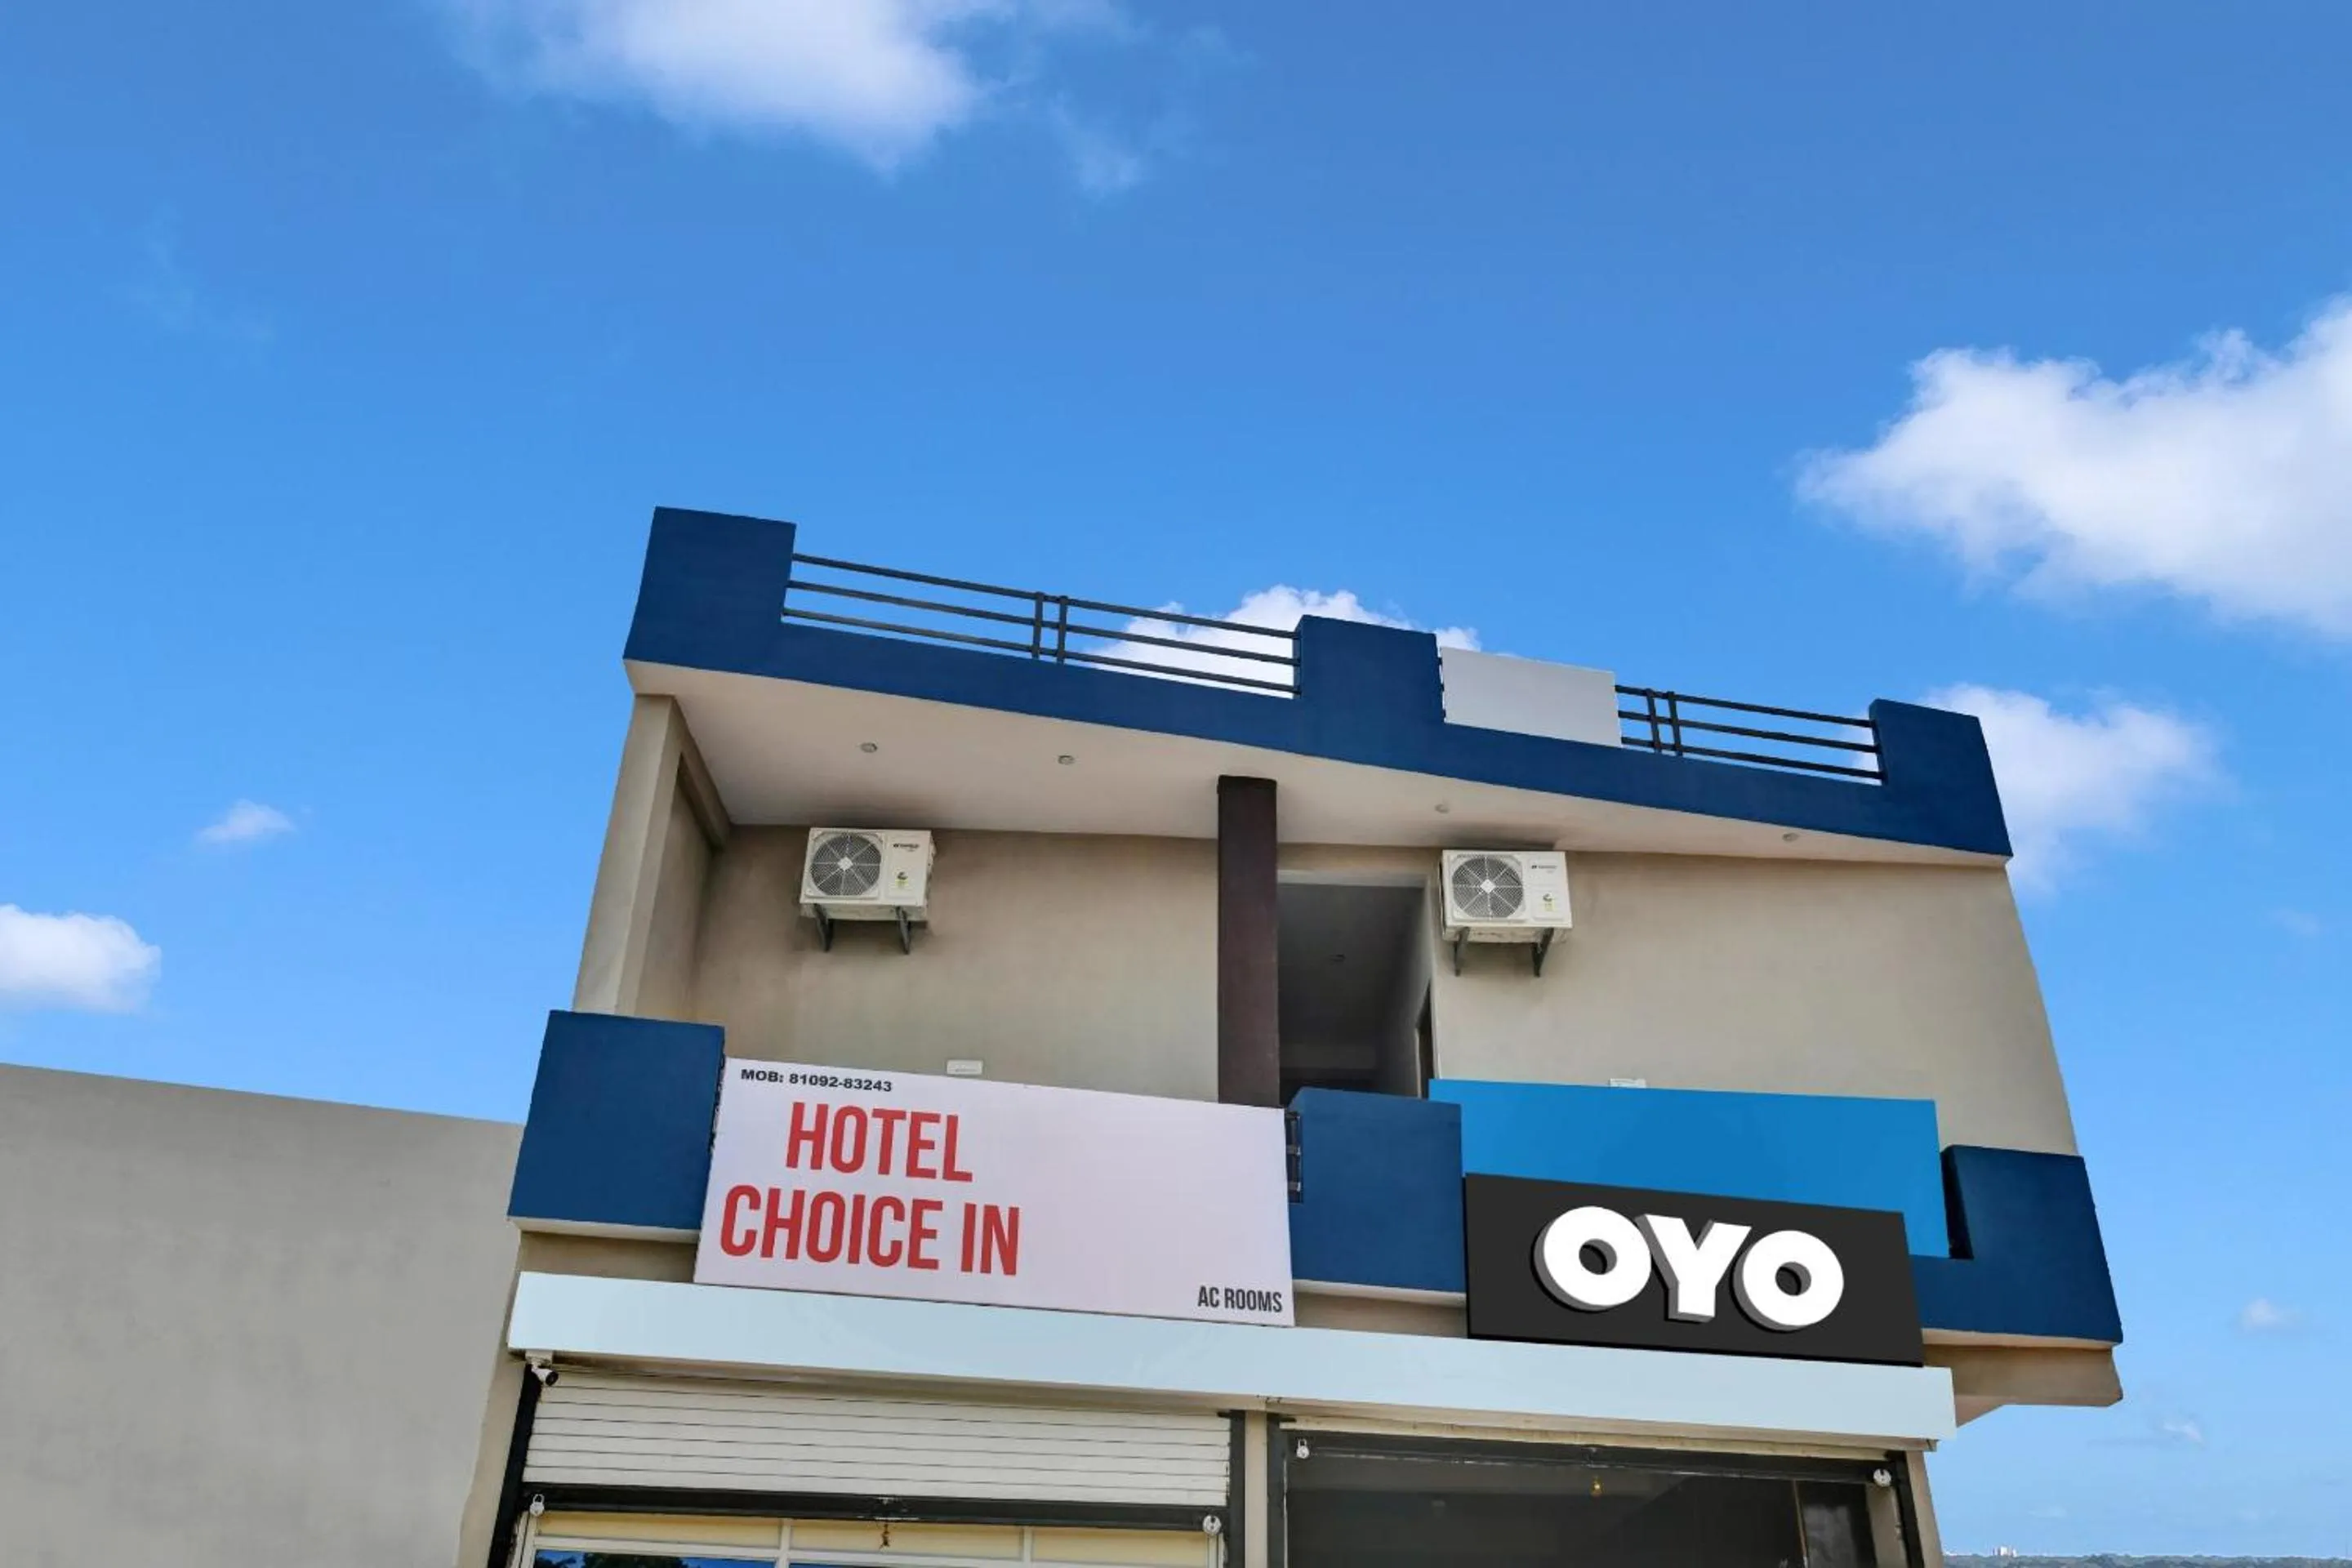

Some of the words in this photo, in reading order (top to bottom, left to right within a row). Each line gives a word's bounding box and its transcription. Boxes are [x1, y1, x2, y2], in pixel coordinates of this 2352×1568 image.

[741, 1068, 784, 1083] MOB:
[789, 1073, 893, 1093] 81092-83243
[786, 1102, 974, 1183] HOTEL
[719, 1183, 944, 1271] CHOICE
[960, 1202, 1020, 1276] IN
[1534, 1205, 1845, 1331] OYO
[1197, 1285, 1220, 1308] AC
[1223, 1287, 1283, 1313] ROOMS
